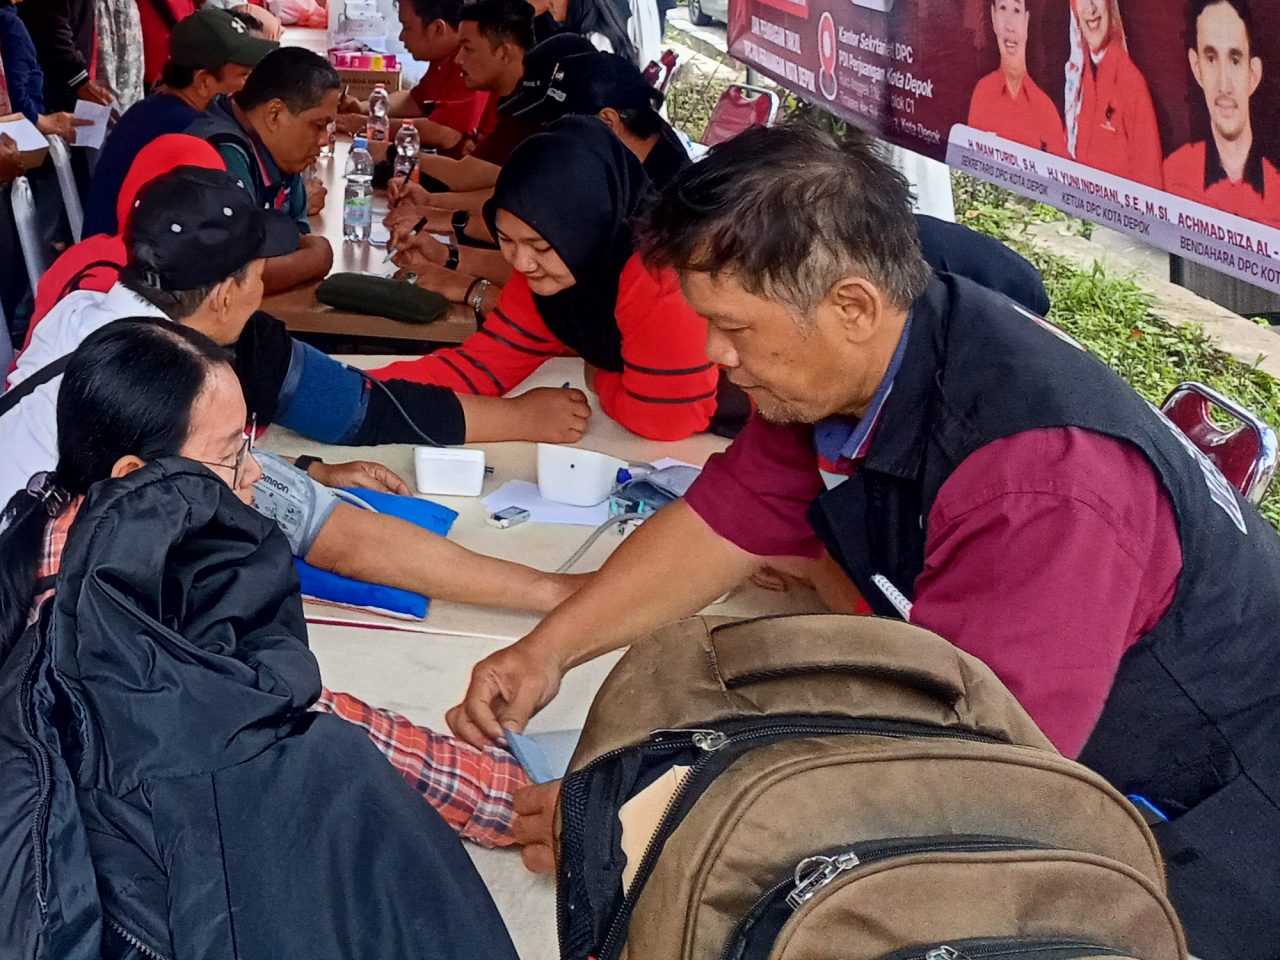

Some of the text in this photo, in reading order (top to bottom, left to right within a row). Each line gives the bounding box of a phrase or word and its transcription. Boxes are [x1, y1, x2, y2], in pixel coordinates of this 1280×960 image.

[895, 42, 913, 64] DPC
[905, 72, 934, 99] Depok
[995, 167, 1008, 182] DPC
[1009, 171, 1026, 189] KOTA
[1026, 177, 1049, 196] DEPOK
[1061, 170, 1080, 190] YUNI
[1061, 191, 1151, 236] KETUA DPC KOTA DEPOK
[1177, 213, 1226, 240] ACHMAD
[1227, 229, 1255, 254] RIZA
[1256, 239, 1272, 258] AL
[1180, 235, 1236, 269] BENDAHARA
[1237, 257, 1259, 276] DPC
